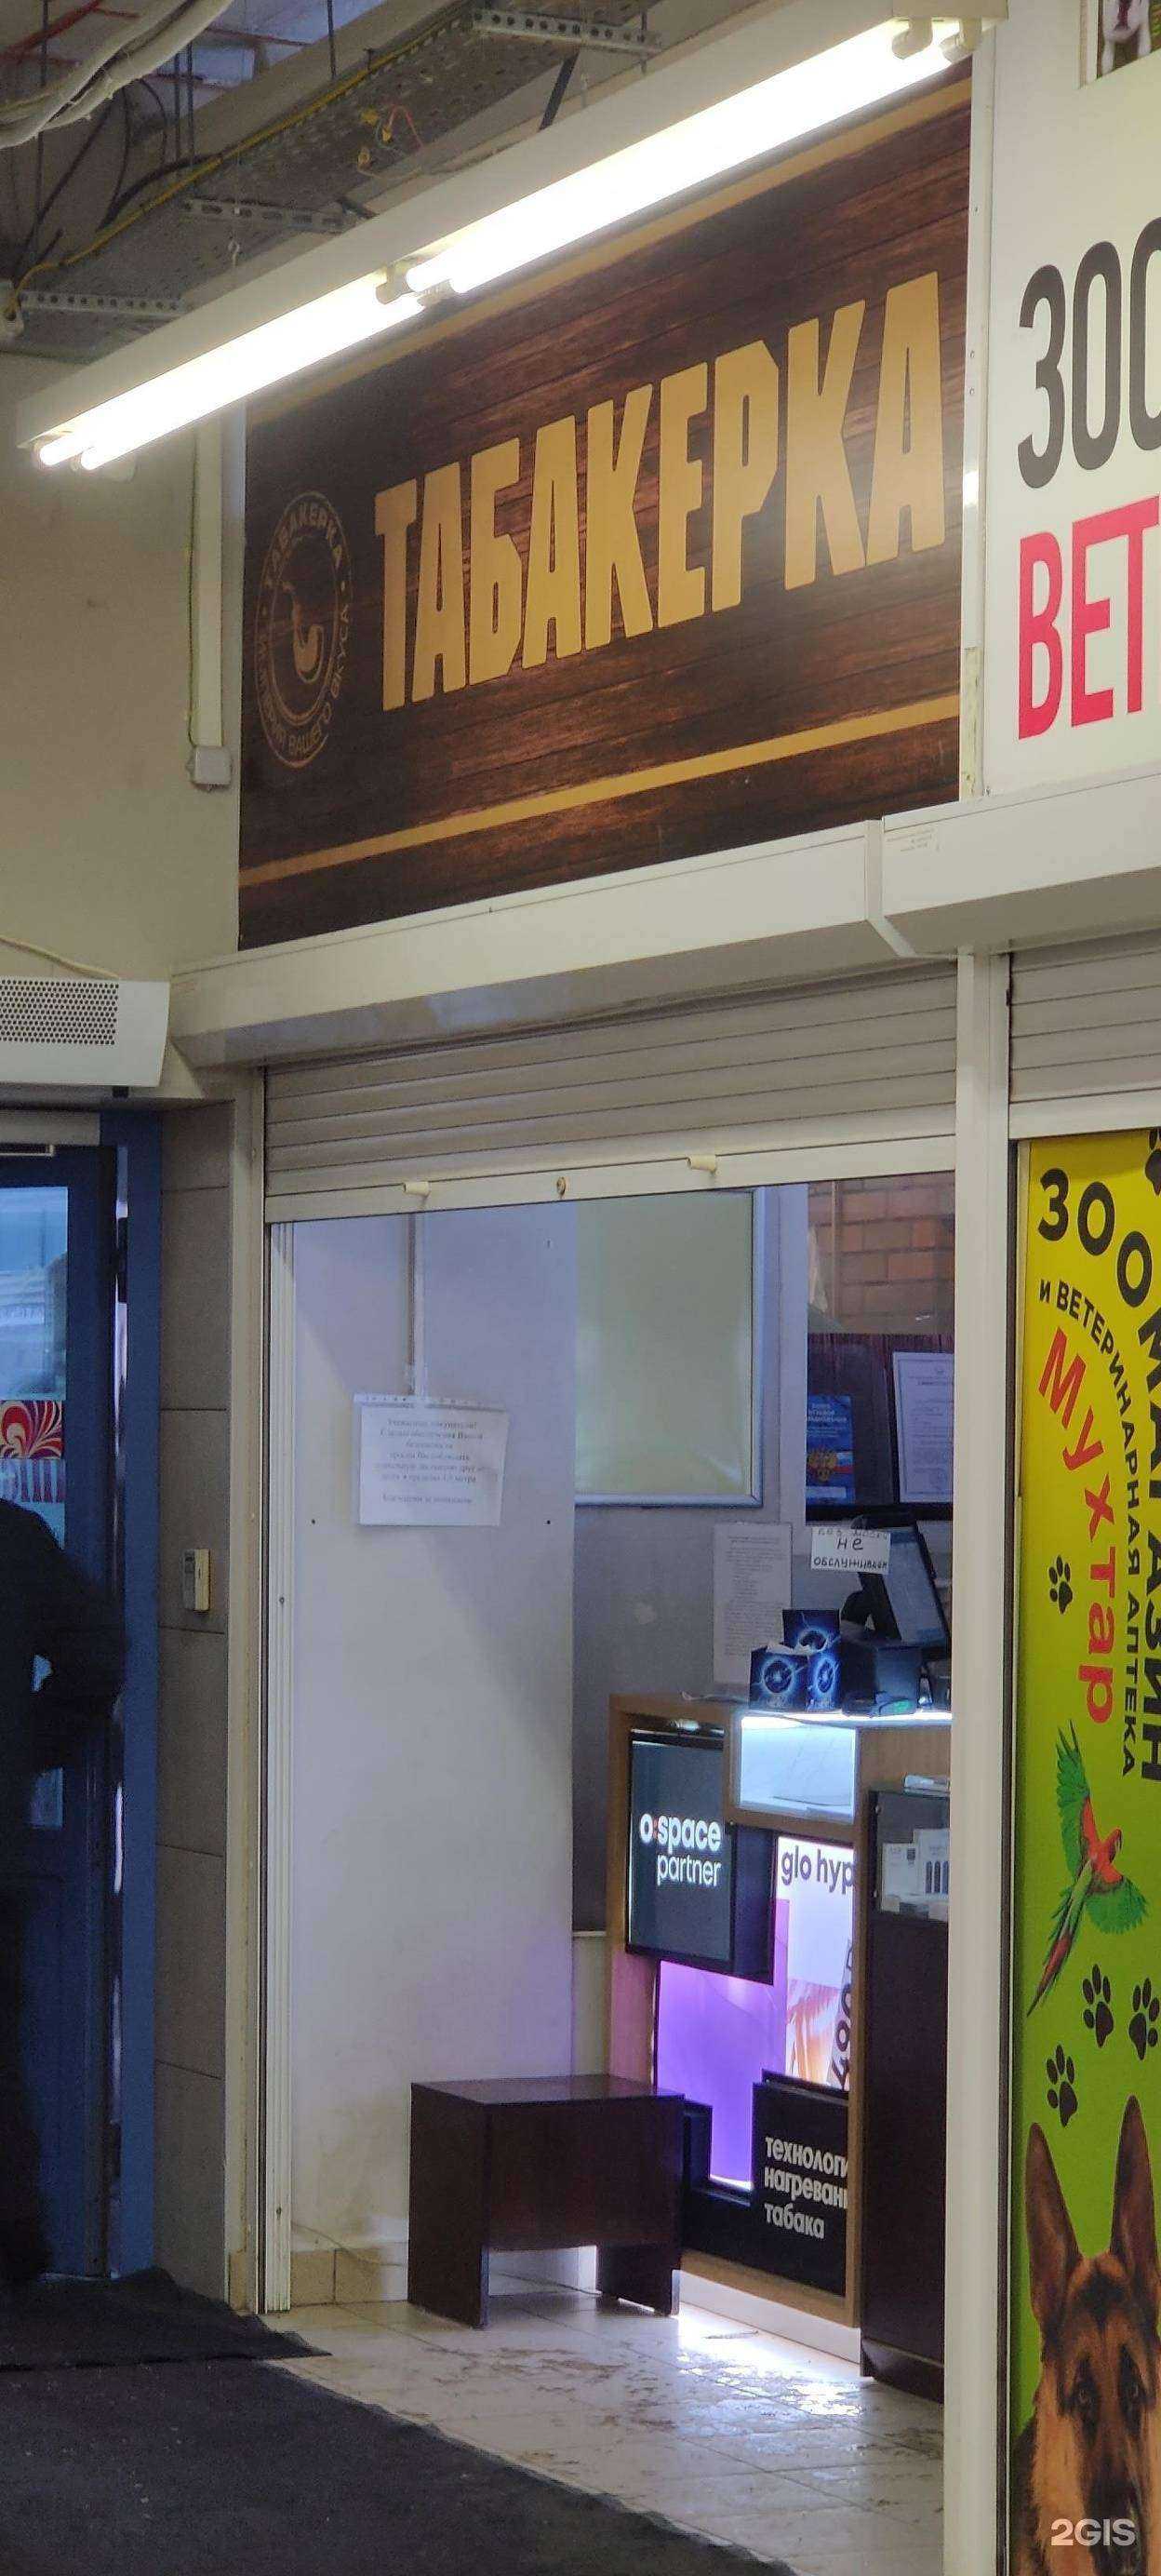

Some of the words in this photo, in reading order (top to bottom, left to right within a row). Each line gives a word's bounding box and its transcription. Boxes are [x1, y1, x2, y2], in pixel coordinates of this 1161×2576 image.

[375, 271, 945, 711] ТАБАКЕРКА
[1019, 495, 1159, 741] ВЕТ
[1057, 1279, 1140, 1575] ВЕТЕРИНАРНАЯ
[1123, 1590, 1141, 1777] АПТЕКА
[657, 1854, 722, 1887] partner
[781, 1845, 812, 1886] glo
[817, 1848, 855, 1895] hyp
[765, 2203, 824, 2239] табака
